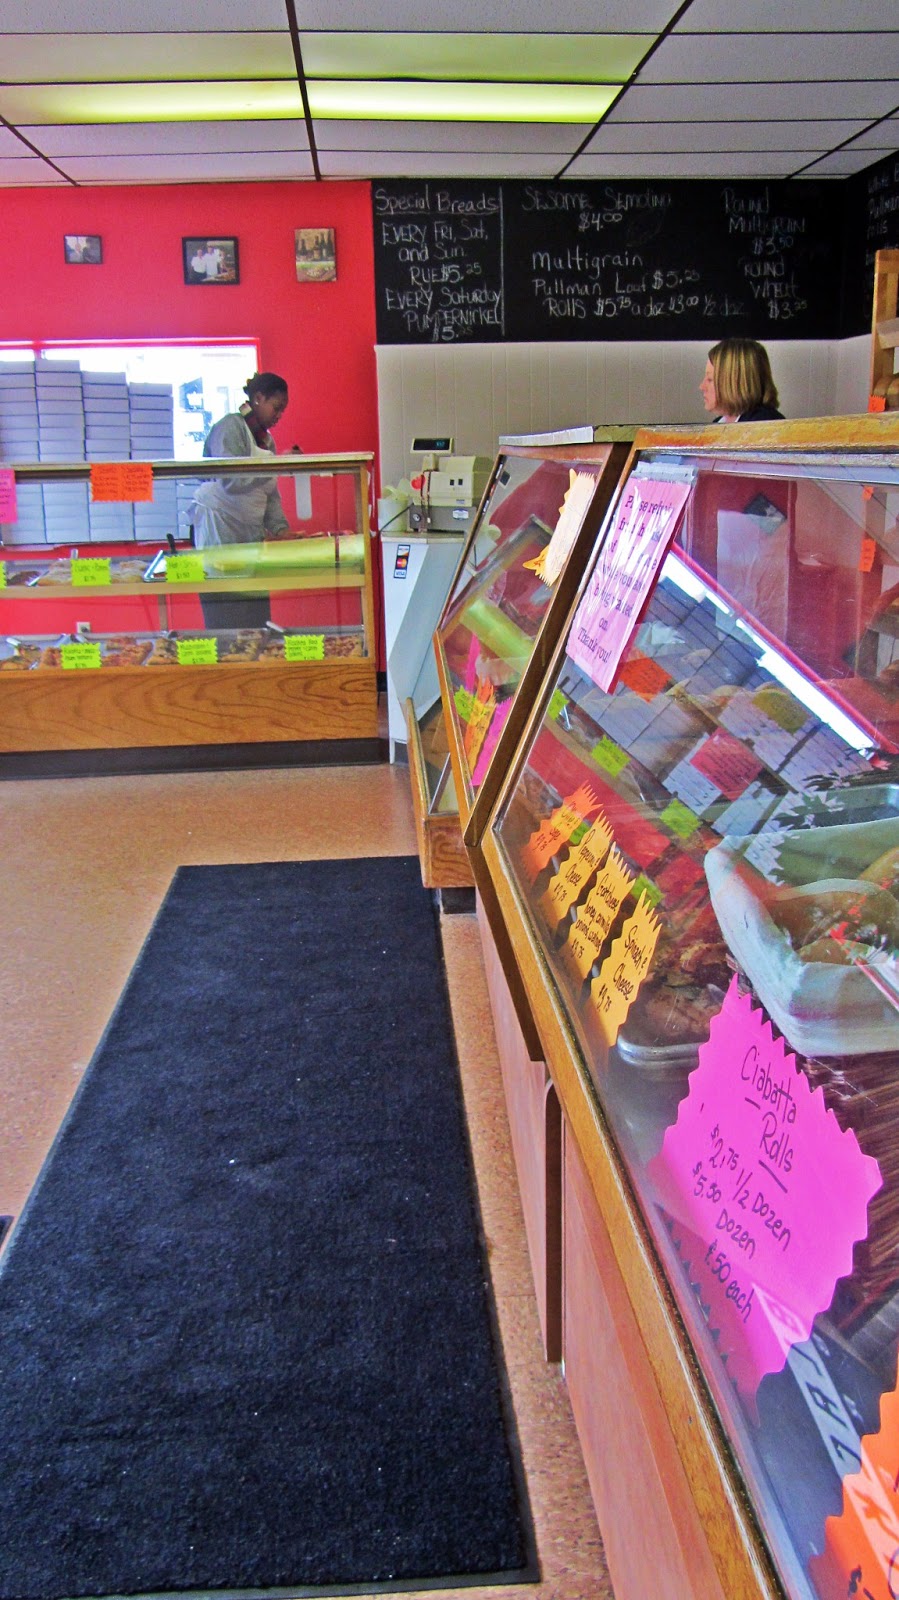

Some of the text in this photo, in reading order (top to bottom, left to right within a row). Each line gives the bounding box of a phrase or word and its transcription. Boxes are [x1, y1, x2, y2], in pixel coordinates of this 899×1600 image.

[375, 184, 499, 214] Special Breads
[398, 243, 428, 262] and
[532, 245, 643, 280] Multigrain
[532, 278, 602, 297] Pullman
[577, 628, 612, 664] Thank you!
[565, 863, 582, 887] Cheese
[623, 925, 646, 970] Spinach
[613, 963, 634, 1000] Cheese
[740, 1045, 797, 1124] Ciabatta
[759, 1111, 794, 1173] Rolls
[692, 1161, 756, 1260] $5.50 Dozen
[732, 1168, 753, 1210] 1/2
[751, 1192, 792, 1251] Dozen
[725, 1280, 755, 1324] each
